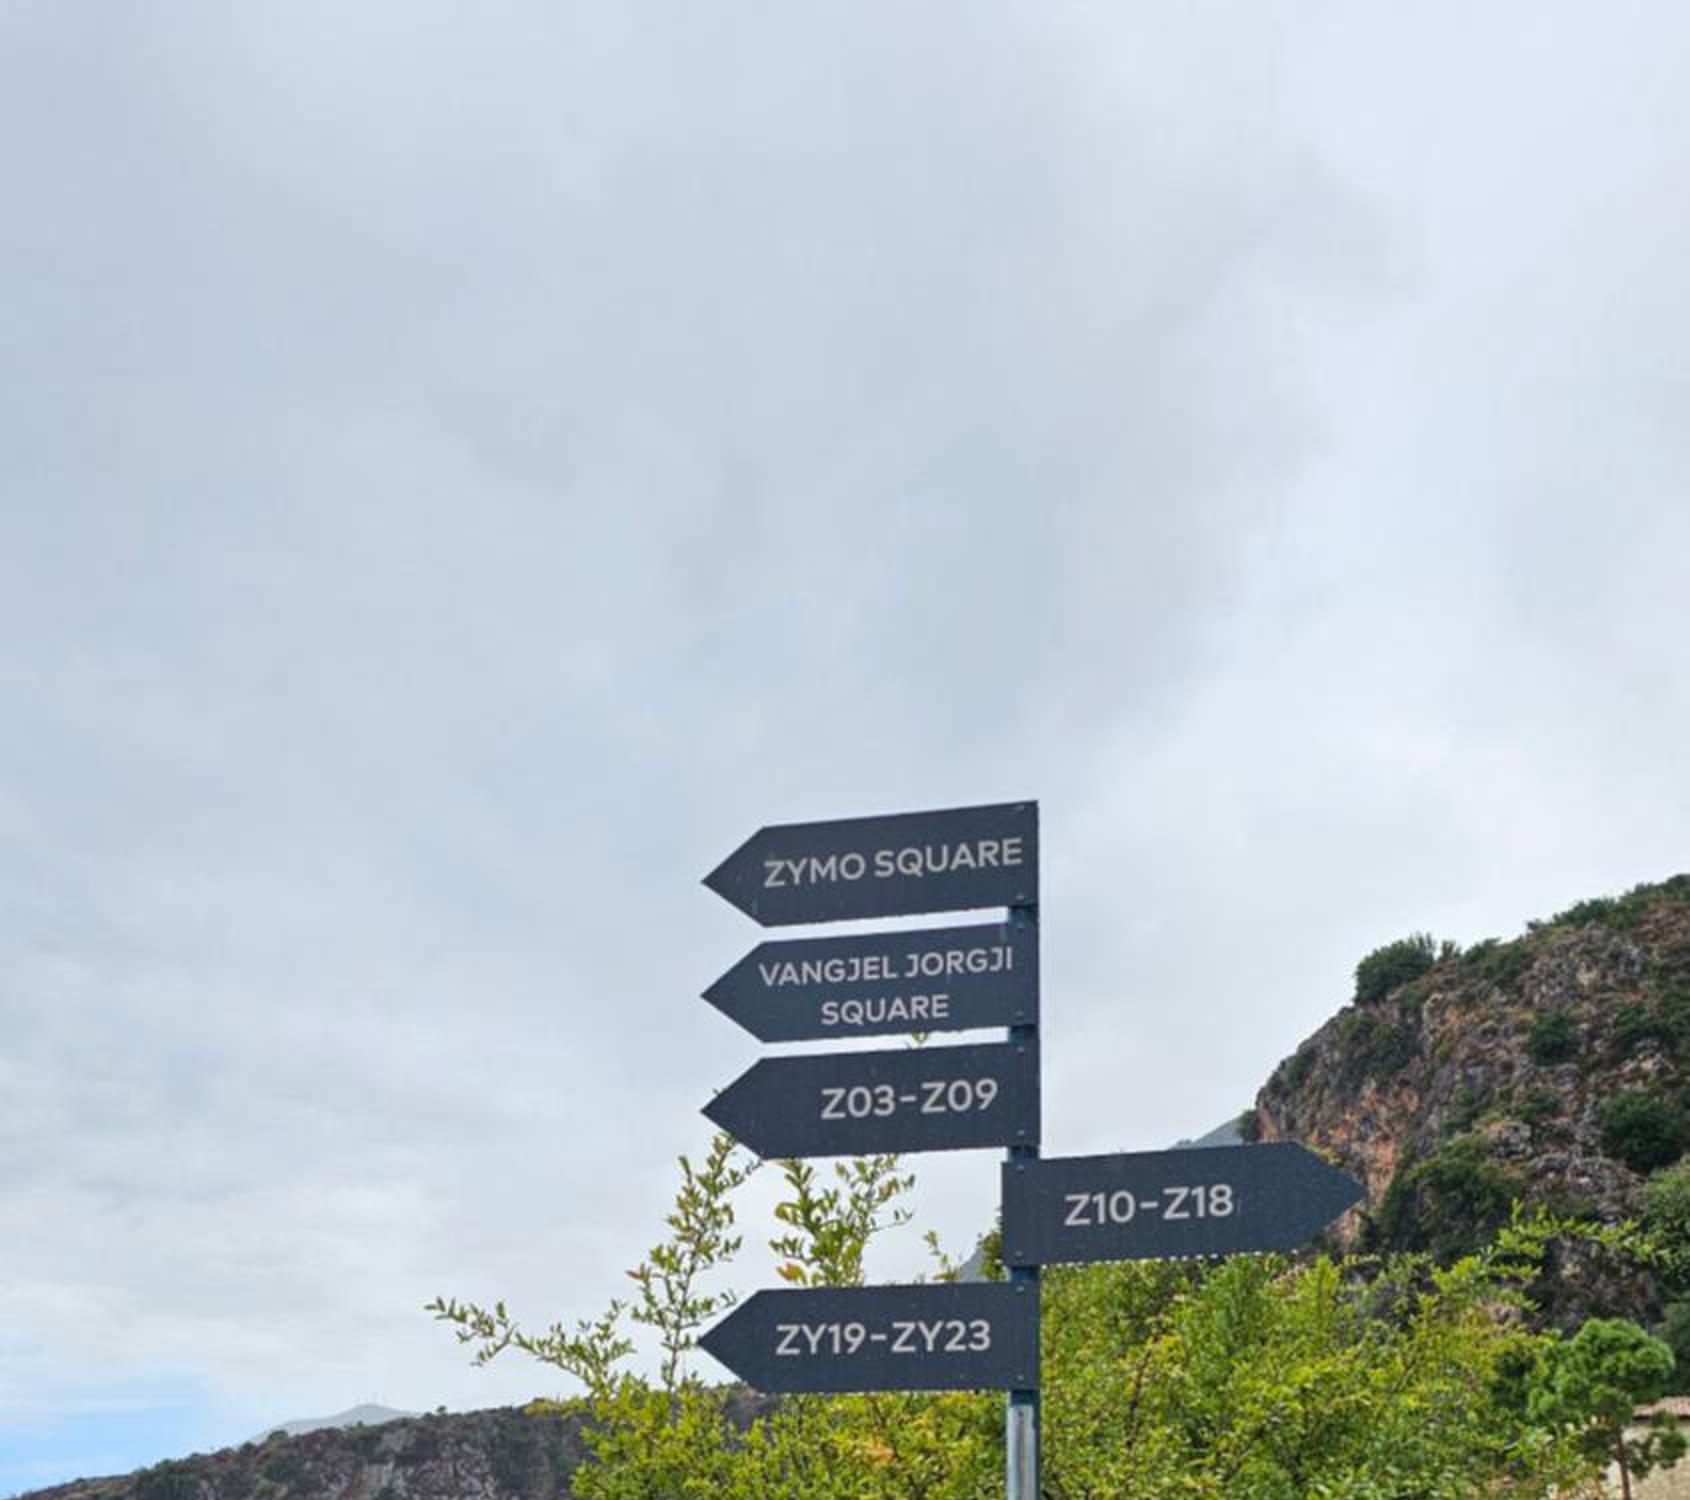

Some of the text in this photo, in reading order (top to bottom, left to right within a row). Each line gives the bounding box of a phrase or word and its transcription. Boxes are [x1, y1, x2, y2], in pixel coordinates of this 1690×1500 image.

[763, 837, 1023, 888] ZYMO SQUARE
[758, 946, 1013, 987] VANGJEL JORGJI
[821, 993, 949, 1026] SQUARE
[820, 1078, 998, 1120] Z03-Z09
[1064, 1183, 1234, 1226] Z10-Z18
[775, 1319, 991, 1356] ZY19-ZY23
